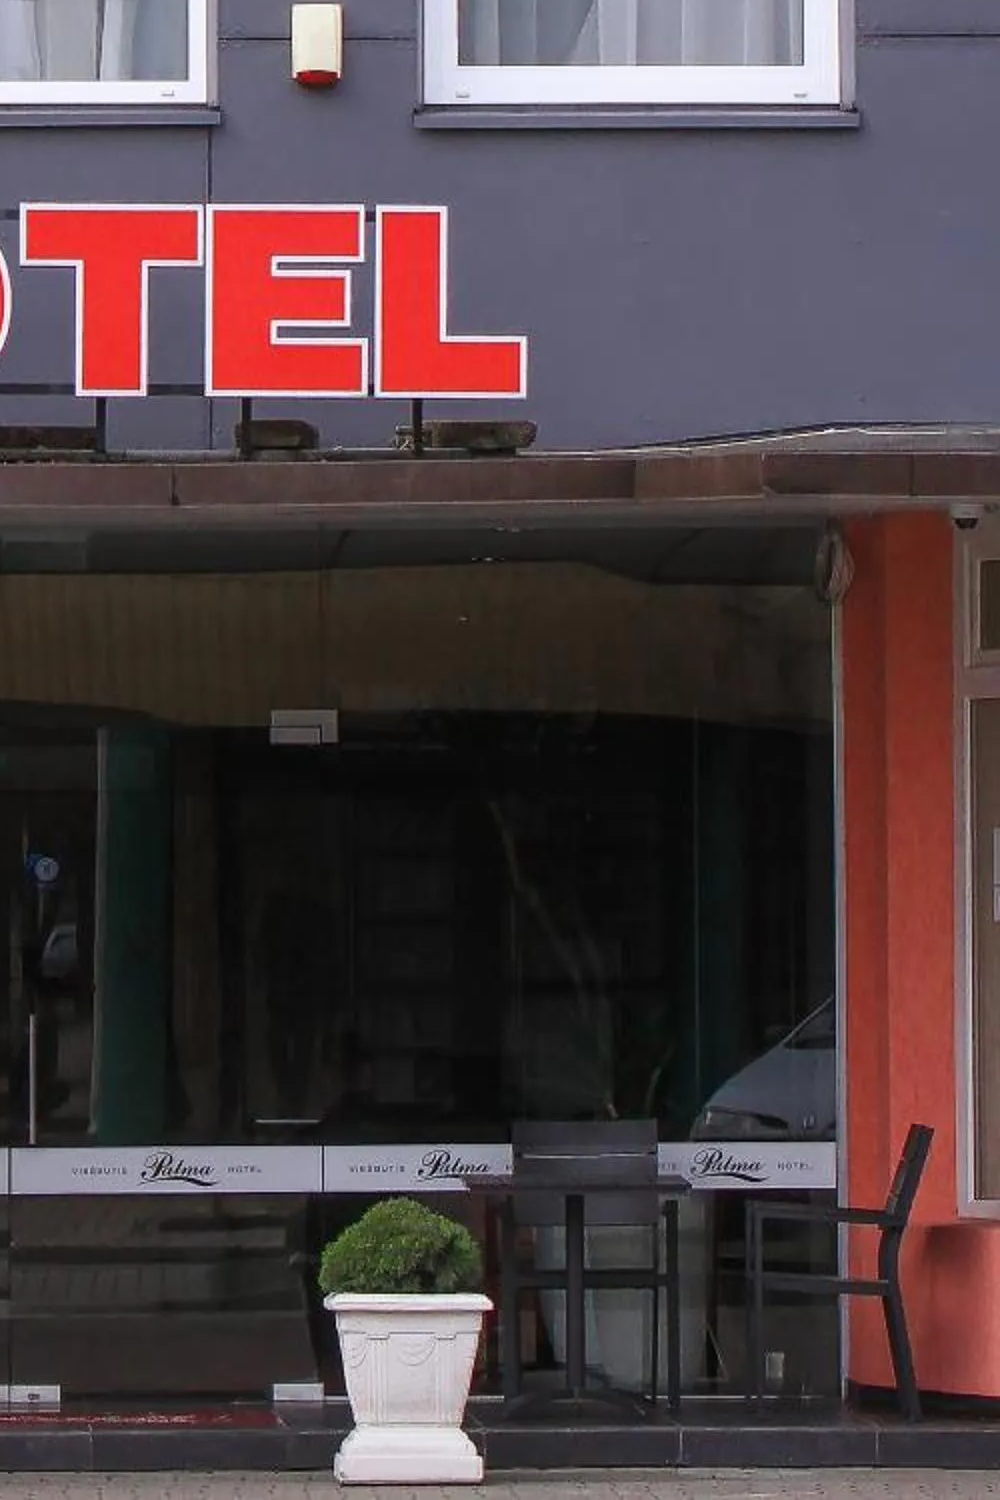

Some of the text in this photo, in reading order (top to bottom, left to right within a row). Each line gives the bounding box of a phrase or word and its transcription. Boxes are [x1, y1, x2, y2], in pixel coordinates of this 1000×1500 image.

[139, 1151, 217, 1186] Palma
[227, 1165, 263, 1174] HOTEL
[417, 1150, 490, 1181] Palma
[690, 1148, 769, 1182] Palma
[777, 1161, 814, 1171] HOTEL
